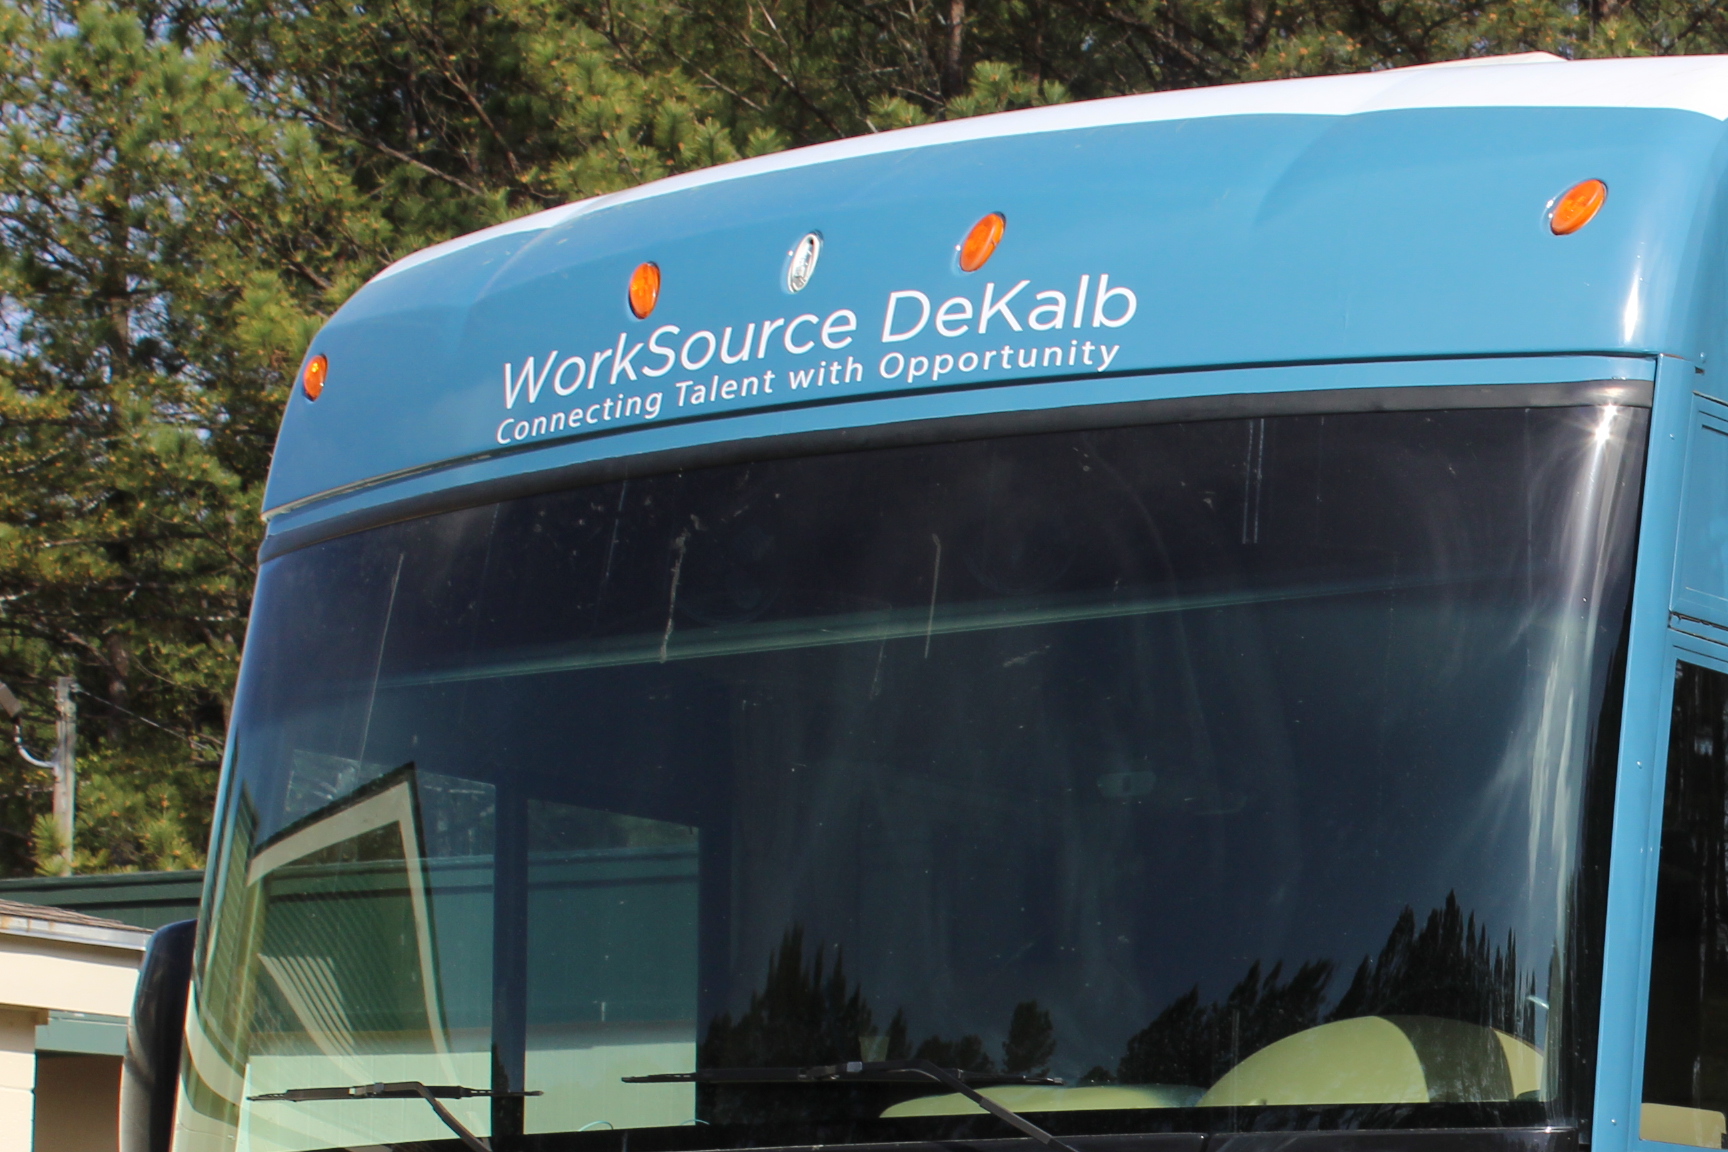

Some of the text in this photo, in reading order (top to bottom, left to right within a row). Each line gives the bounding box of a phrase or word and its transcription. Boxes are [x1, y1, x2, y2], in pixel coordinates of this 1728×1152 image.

[496, 340, 1120, 445] Connecting Talent with Opportunity
[503, 274, 1138, 409] WorkSource DeKalb
